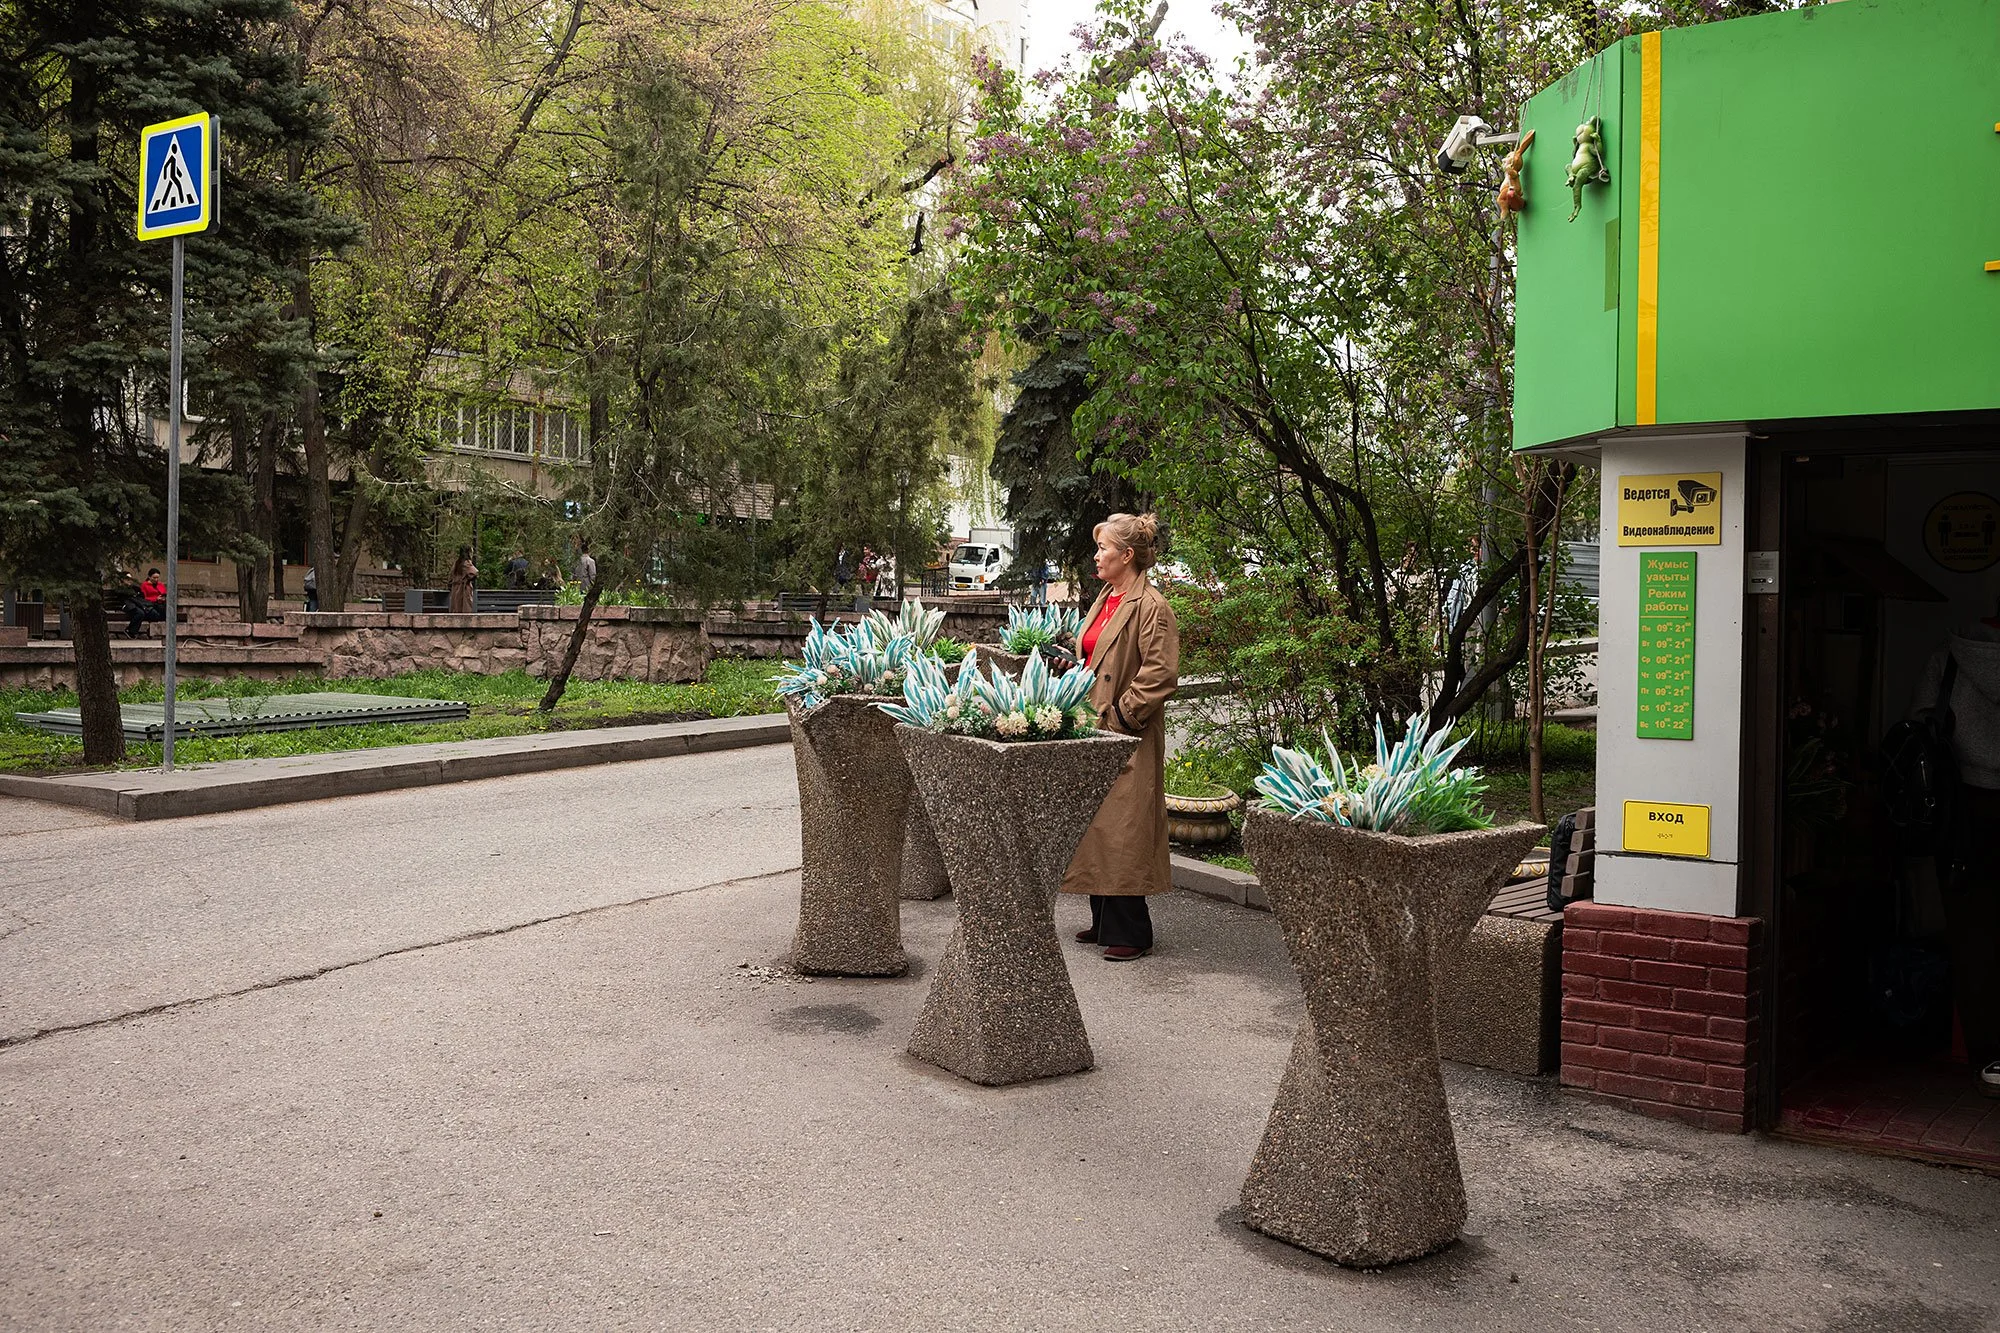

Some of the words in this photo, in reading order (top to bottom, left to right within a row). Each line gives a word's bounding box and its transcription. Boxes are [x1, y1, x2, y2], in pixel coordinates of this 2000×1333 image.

[1623, 488, 1670, 501] Ведется
[1623, 525, 1715, 537] Видеонаблюдение
[1648, 589, 1687, 598] Режим
[1645, 602, 1689, 613] работы
[1649, 811, 1684, 824] ВХОД
